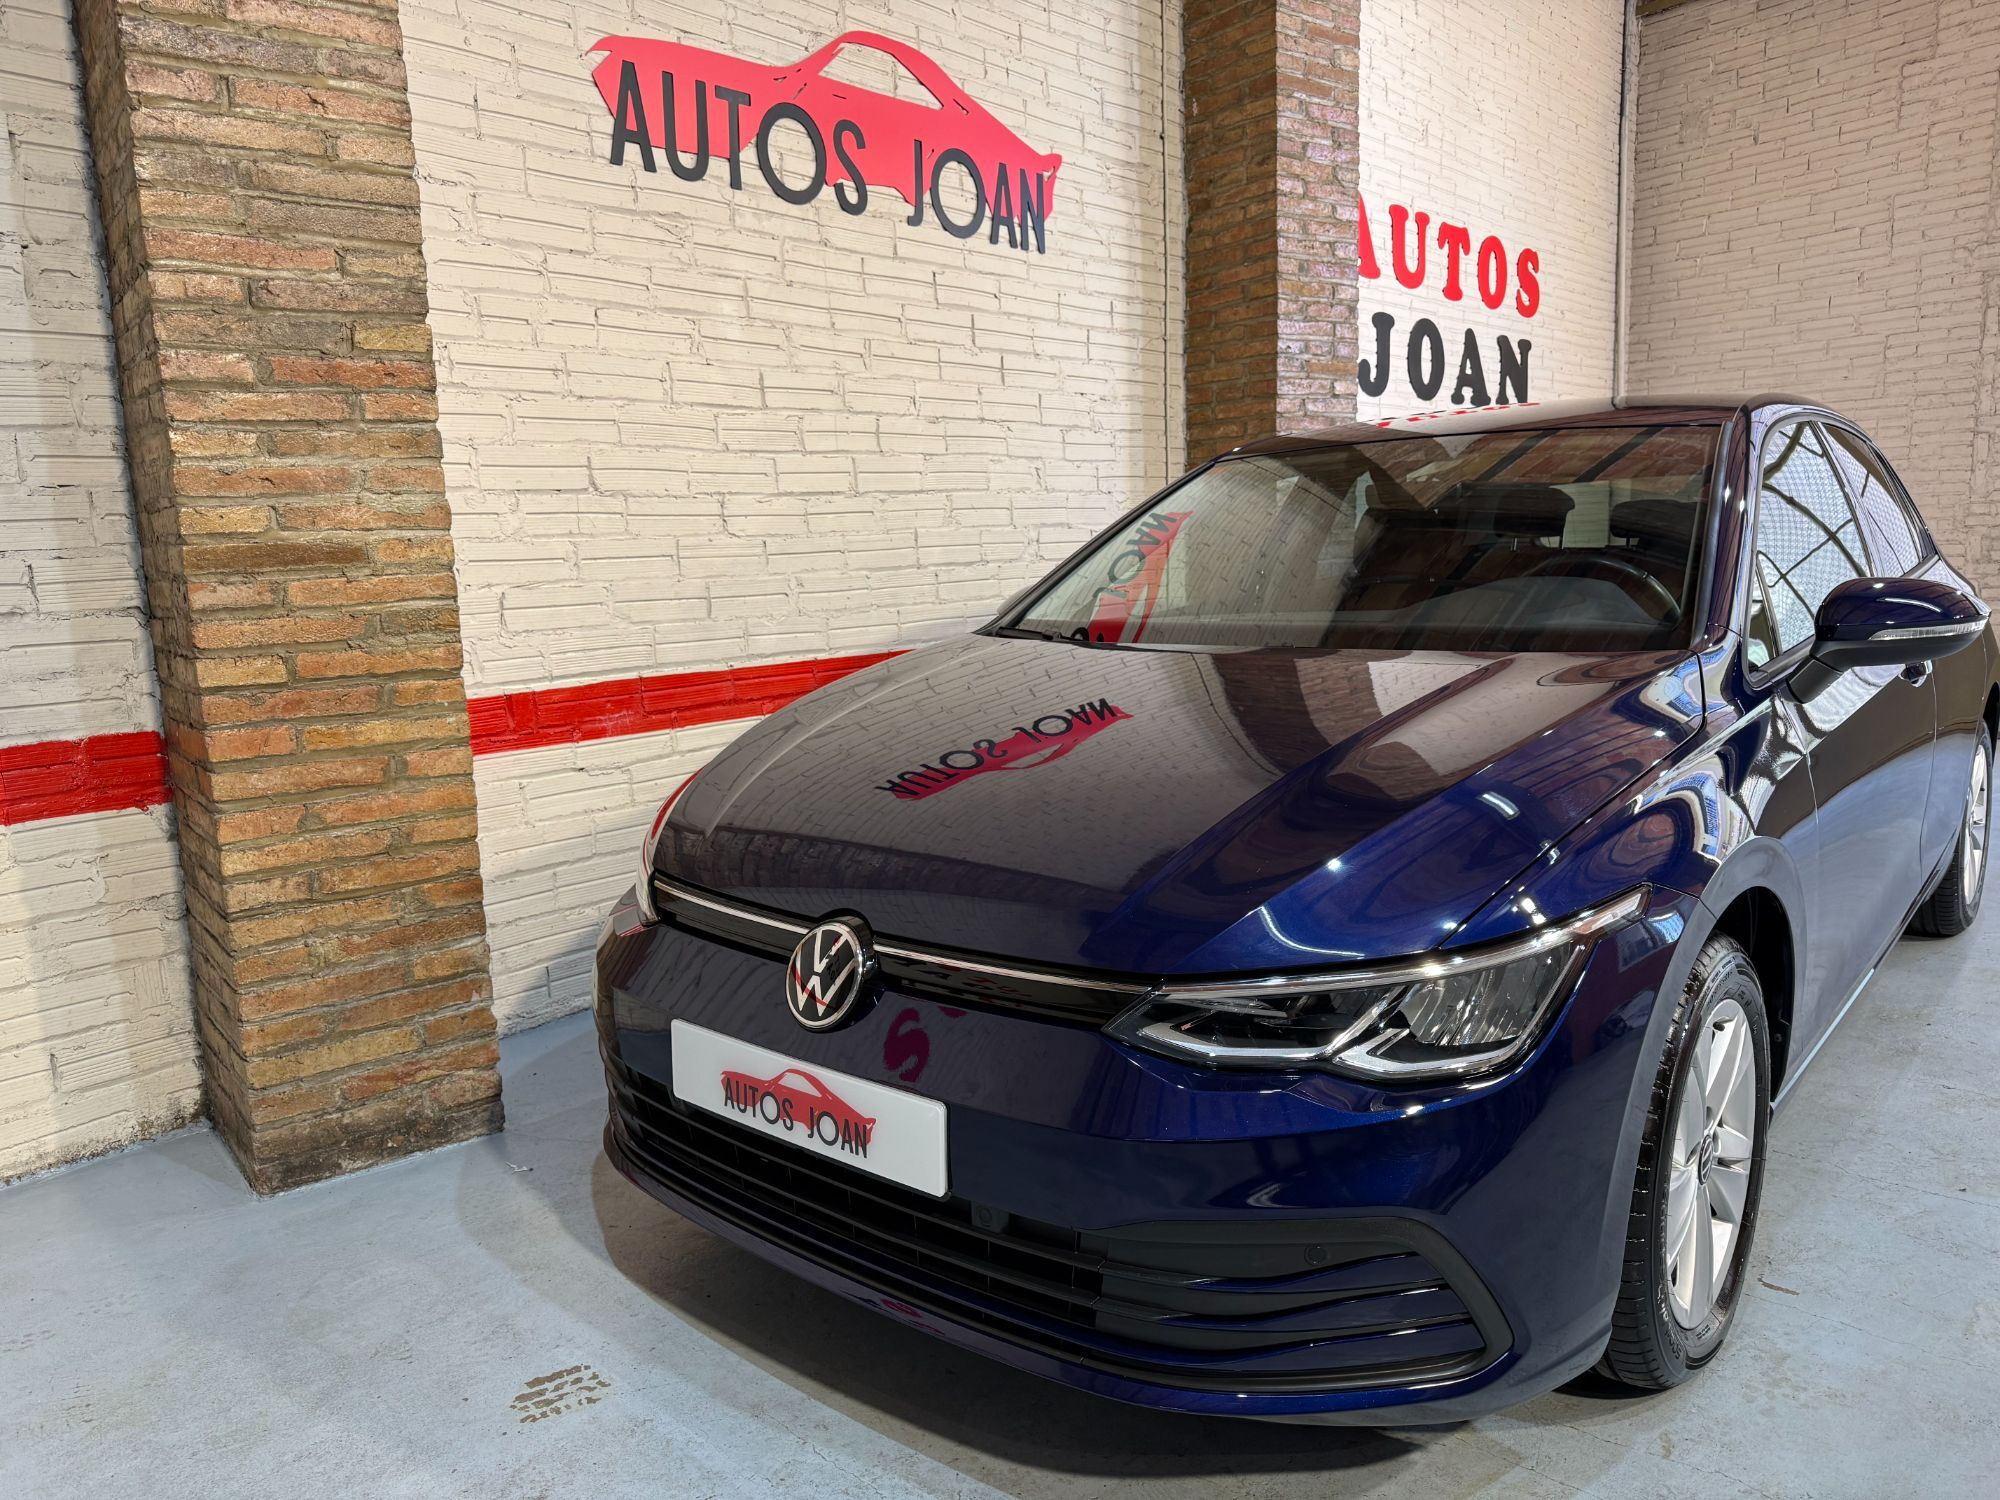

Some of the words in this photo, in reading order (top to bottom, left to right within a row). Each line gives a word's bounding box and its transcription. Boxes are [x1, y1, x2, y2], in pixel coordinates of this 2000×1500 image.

[609, 60, 868, 216] AUTOS
[907, 139, 1046, 254] JOAN
[1358, 312, 1532, 406] JOAN
[723, 1077, 794, 1131] AUTOS
[808, 1106, 869, 1159] JOAN
